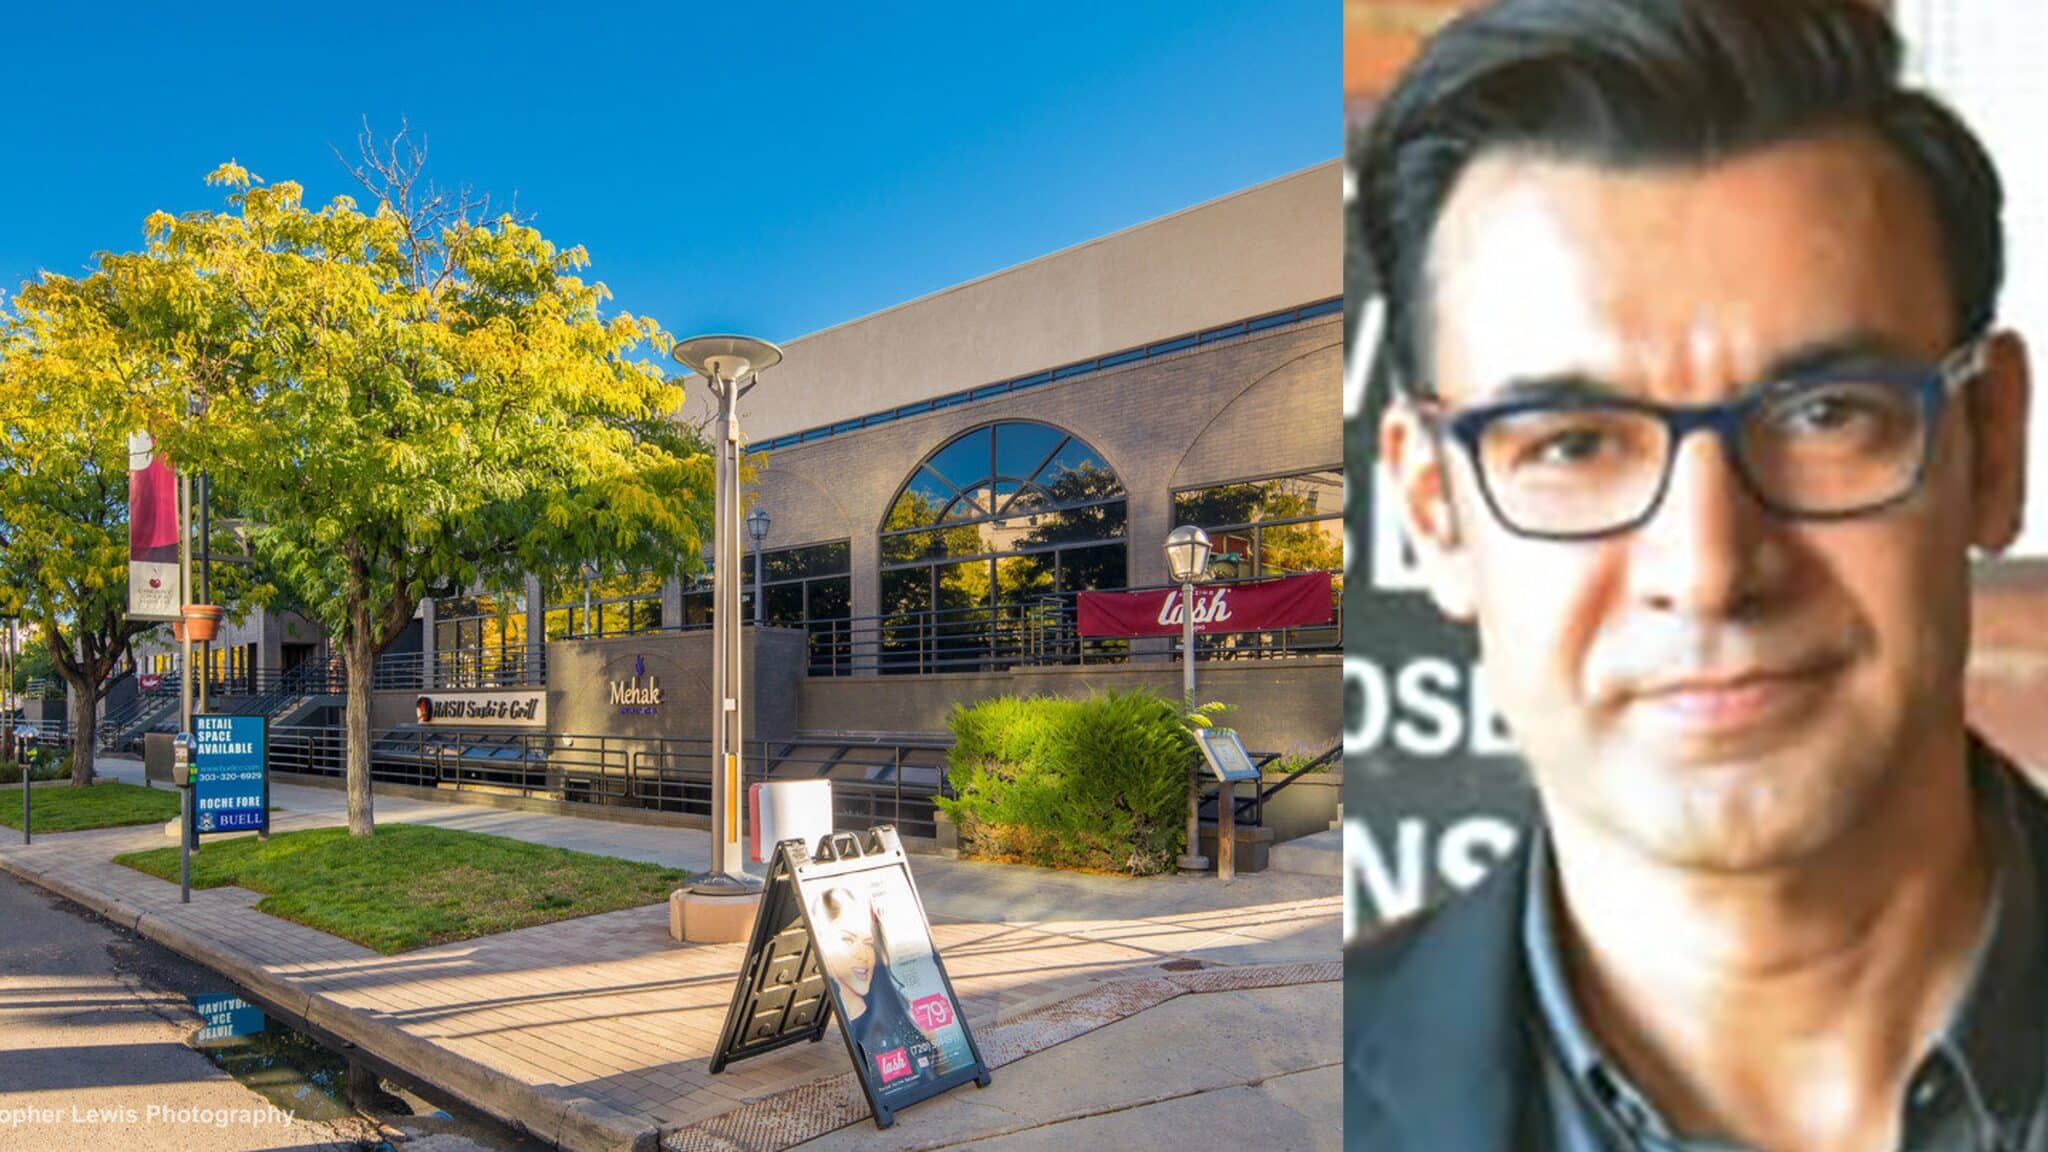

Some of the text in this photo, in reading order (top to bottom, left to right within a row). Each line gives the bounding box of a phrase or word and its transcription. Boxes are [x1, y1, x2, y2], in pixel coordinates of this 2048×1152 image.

[1157, 588, 1232, 625] lash
[610, 676, 660, 705] Mehak
[466, 699, 497, 719] Sushi
[497, 701, 508, 718] &
[510, 698, 539, 720] Grill
[198, 718, 233, 730] RETAIL
[198, 730, 232, 742] SPACE
[198, 743, 254, 754] AVAILABLE
[200, 796, 260, 809] ROCHE FORE
[220, 813, 263, 826] BUELL
[882, 1051, 907, 1075] lash
